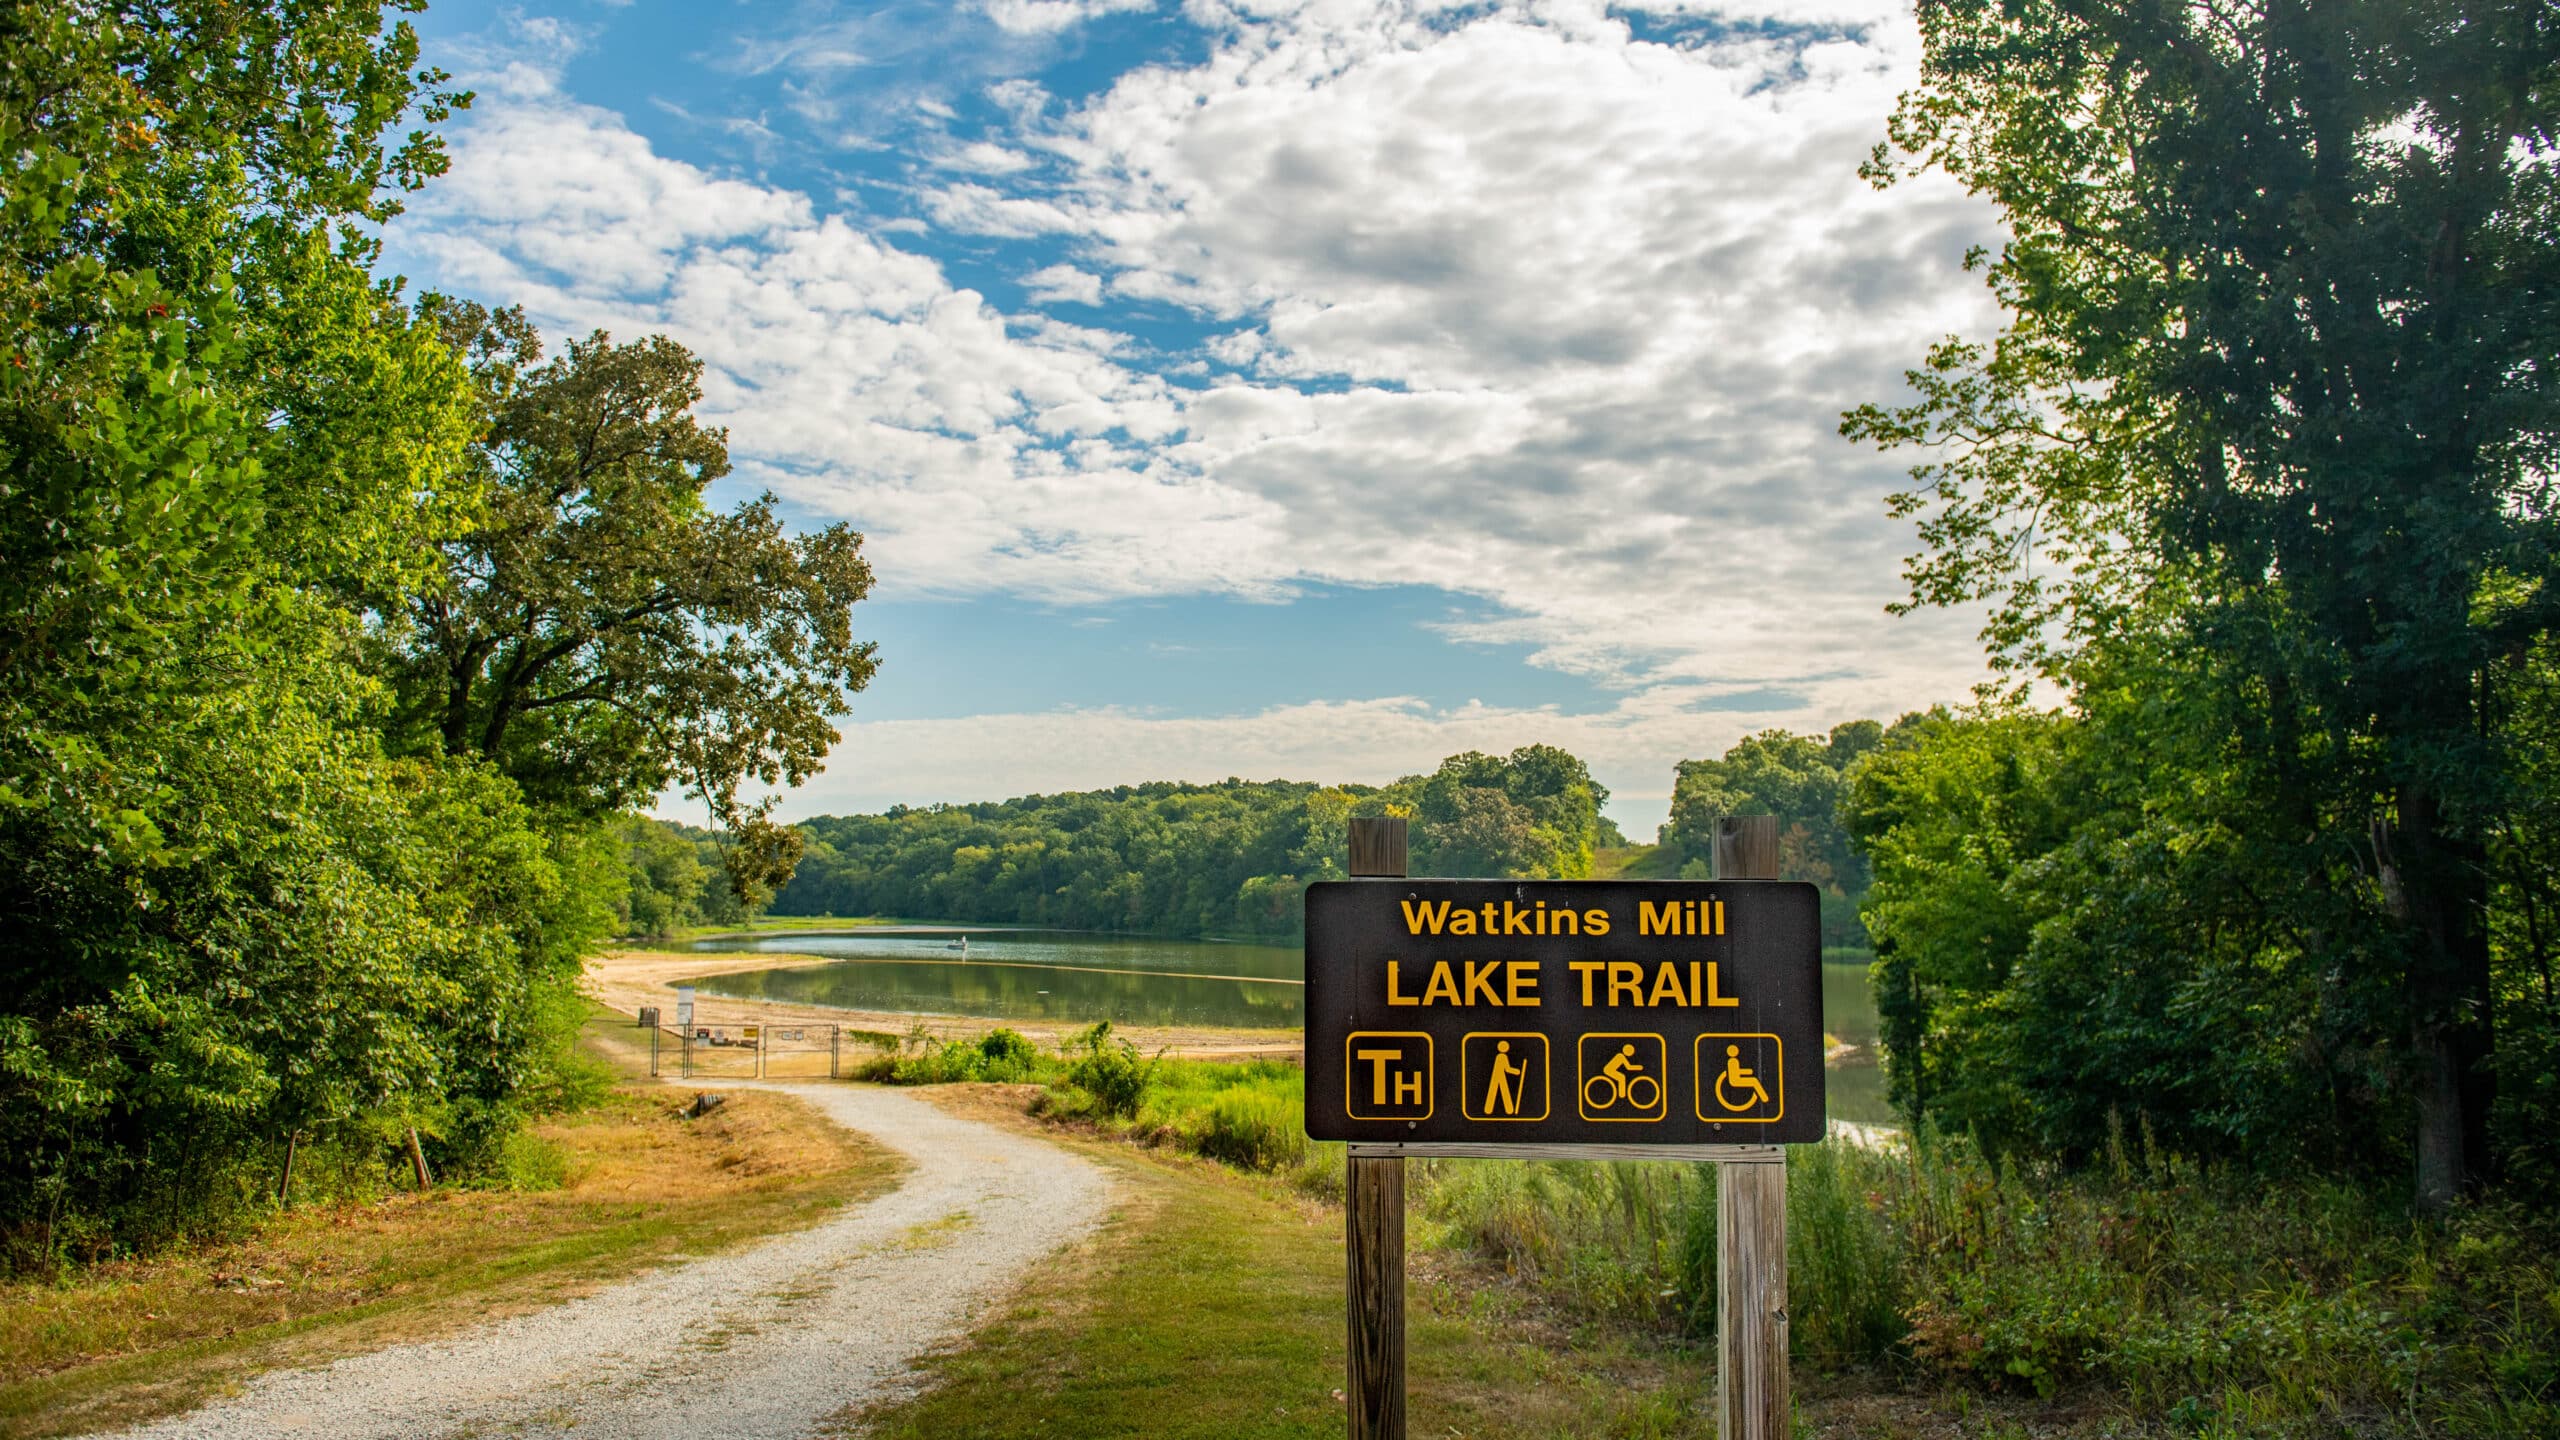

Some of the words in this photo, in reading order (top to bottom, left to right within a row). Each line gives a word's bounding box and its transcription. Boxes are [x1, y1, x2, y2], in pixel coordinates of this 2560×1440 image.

[1400, 900, 1611, 936] Watkins
[1638, 901, 1726, 936] Mill
[1386, 960, 1541, 1007] LAKE
[1568, 961, 1740, 1007] TRAIL
